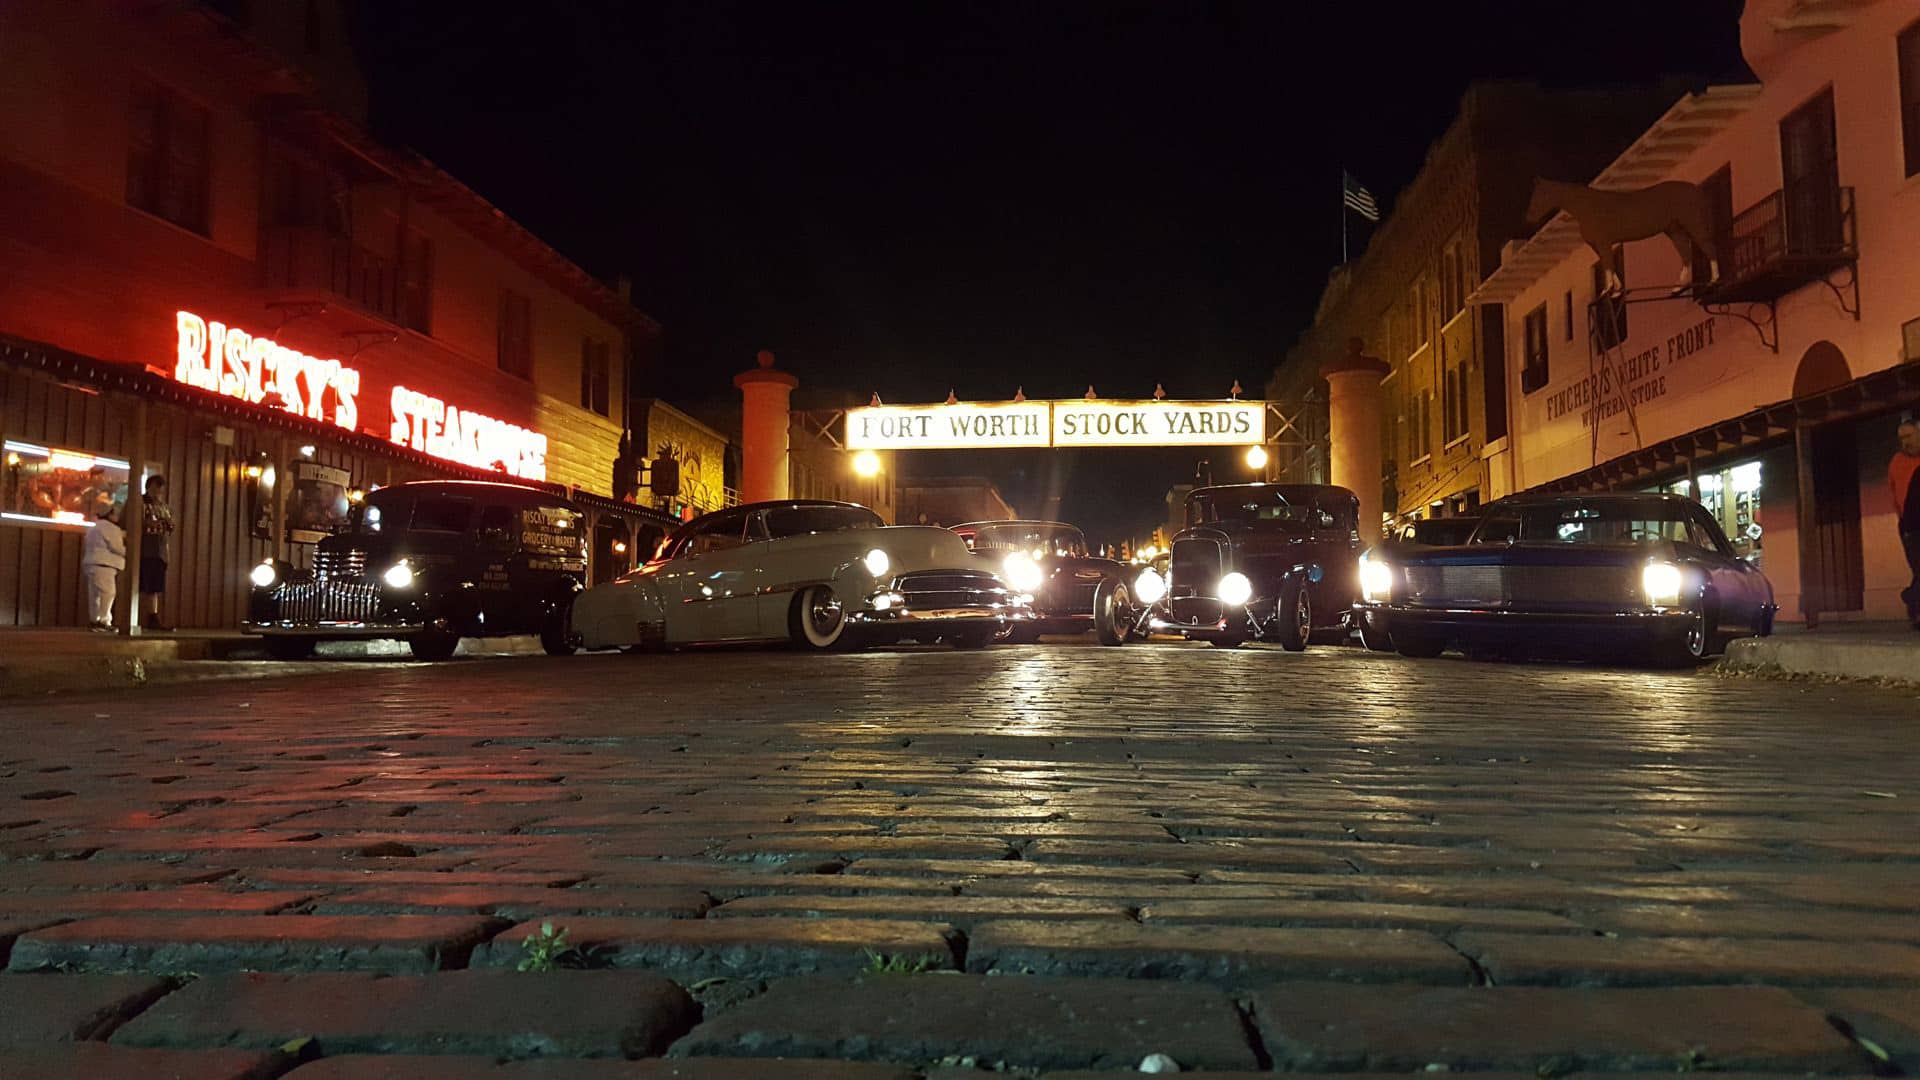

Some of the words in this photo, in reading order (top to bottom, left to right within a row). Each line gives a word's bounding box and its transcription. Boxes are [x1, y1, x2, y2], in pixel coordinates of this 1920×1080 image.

[1618, 347, 1660, 385] WHITE
[1667, 317, 1716, 364] FRONT
[175, 310, 360, 432] RISCKY'S
[390, 385, 547, 482] STEAKSE
[1631, 376, 1667, 407] STORE
[862, 414, 933, 438] FORT
[950, 412, 1039, 437] WORTH
[1063, 410, 1148, 436] STOCK
[1164, 410, 1251, 435] YARDS
